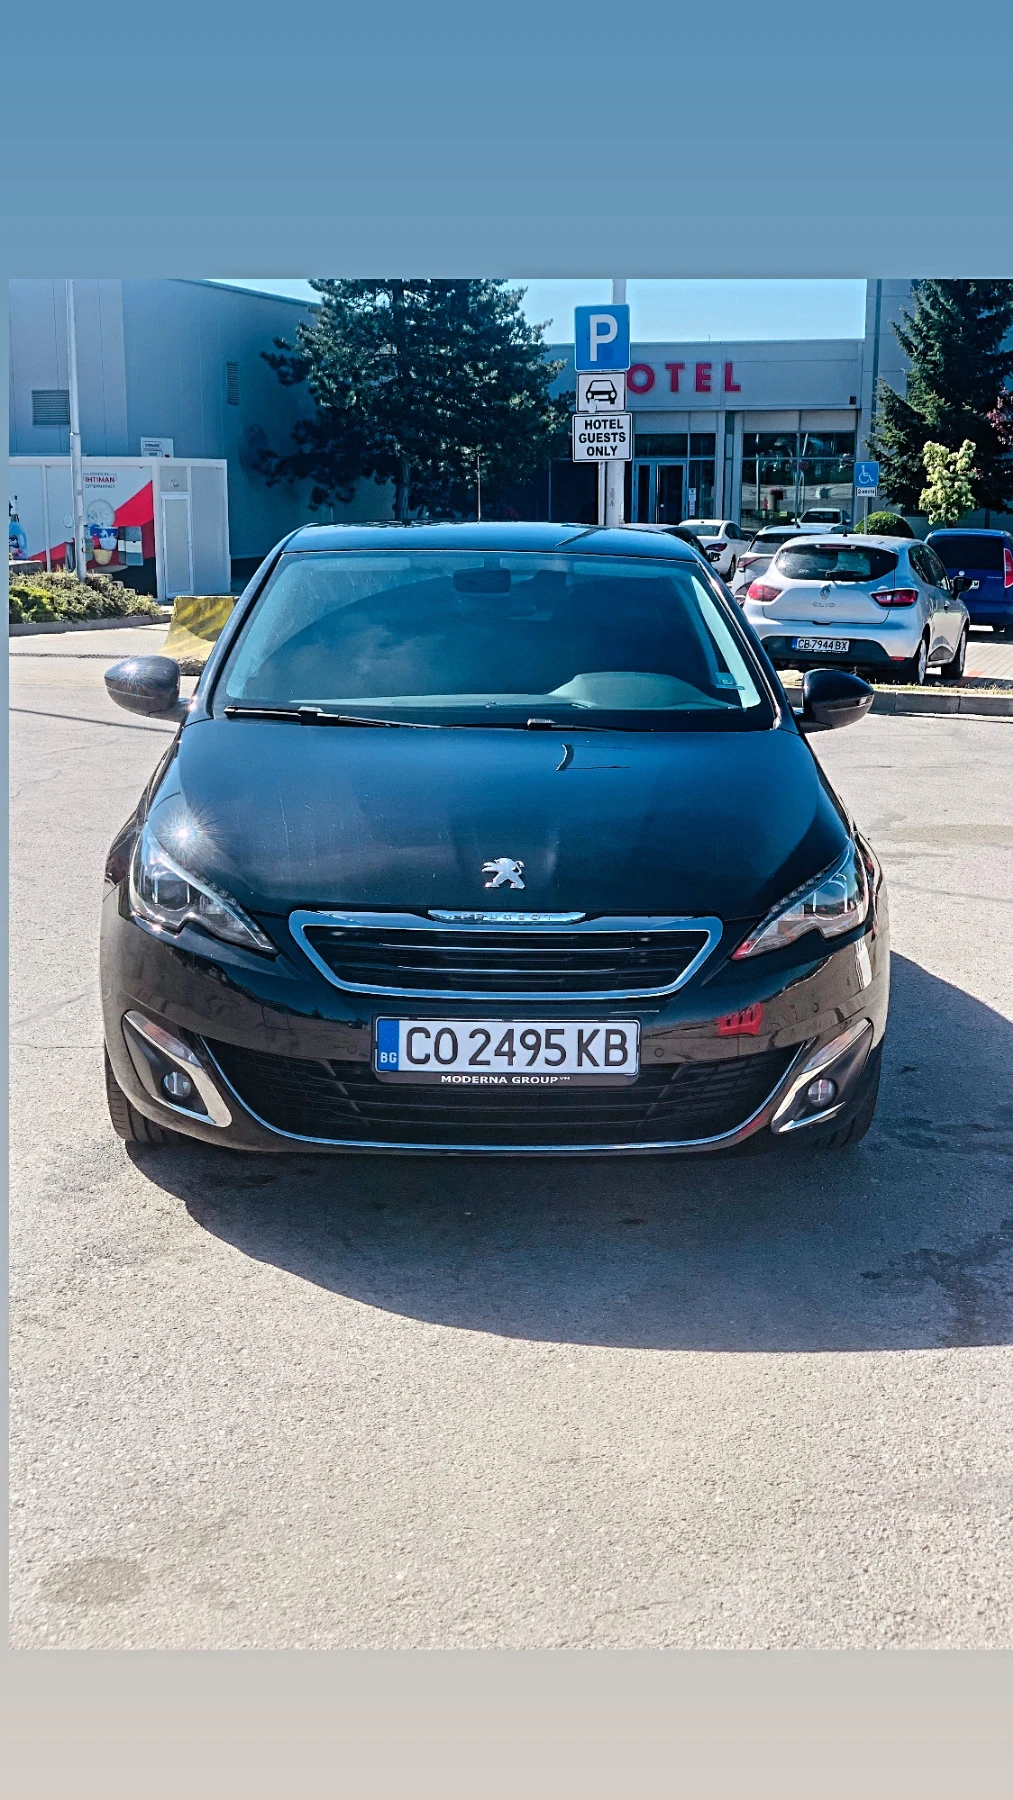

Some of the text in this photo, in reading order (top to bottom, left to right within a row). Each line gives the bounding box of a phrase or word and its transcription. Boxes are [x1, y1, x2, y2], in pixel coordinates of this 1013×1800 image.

[589, 313, 618, 362] P
[626, 362, 741, 394] OTEL
[584, 419, 624, 430] HOTEL
[578, 431, 626, 443] GUESTS
[586, 445, 618, 457] ONLY
[811, 640, 834, 650] 7944
[835, 641, 848, 651] BX
[468, 1028, 567, 1067] 2495
[576, 1028, 629, 1067] KB
[380, 1052, 397, 1064] BG
[441, 1075, 508, 1084] MODERNA
